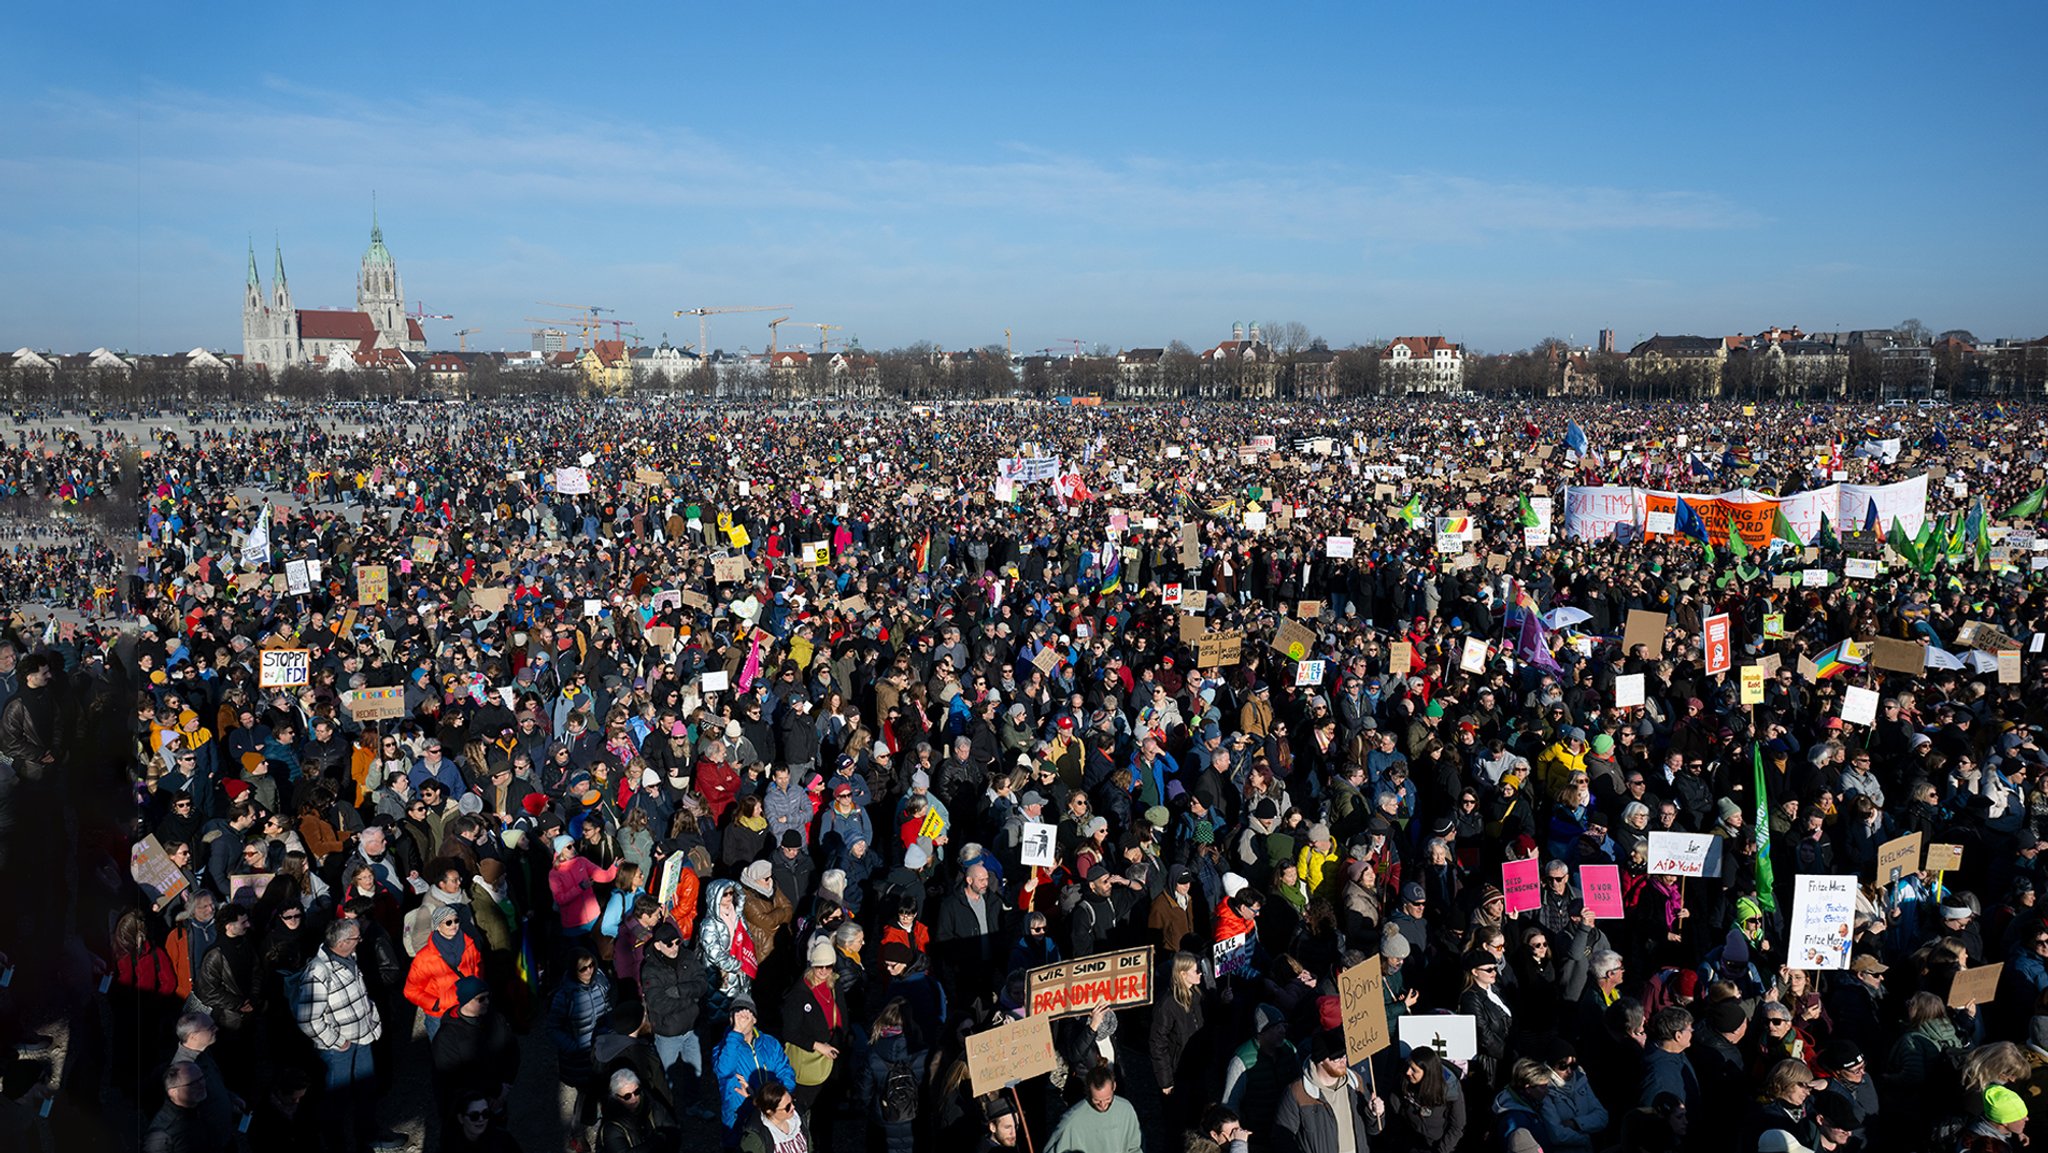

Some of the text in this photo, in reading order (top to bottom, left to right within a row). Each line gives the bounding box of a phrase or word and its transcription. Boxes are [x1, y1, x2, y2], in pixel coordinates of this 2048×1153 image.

[1758, 508, 1775, 521] IST
[263, 651, 308, 667] STOPPT
[1300, 662, 1322, 672] VIEL
[275, 667, 307, 683] AFD!
[1298, 671, 1322, 680] FALT
[355, 708, 379, 719] RECHTE
[1505, 877, 1522, 886] SEID
[1505, 882, 1539, 893] MENSCHEN
[1597, 883, 1612, 891] VOR
[1039, 954, 1143, 983] WIR SIND DIE
[1034, 974, 1149, 1015] BRANDMAUER!
[1347, 1009, 1369, 1030] gegen
